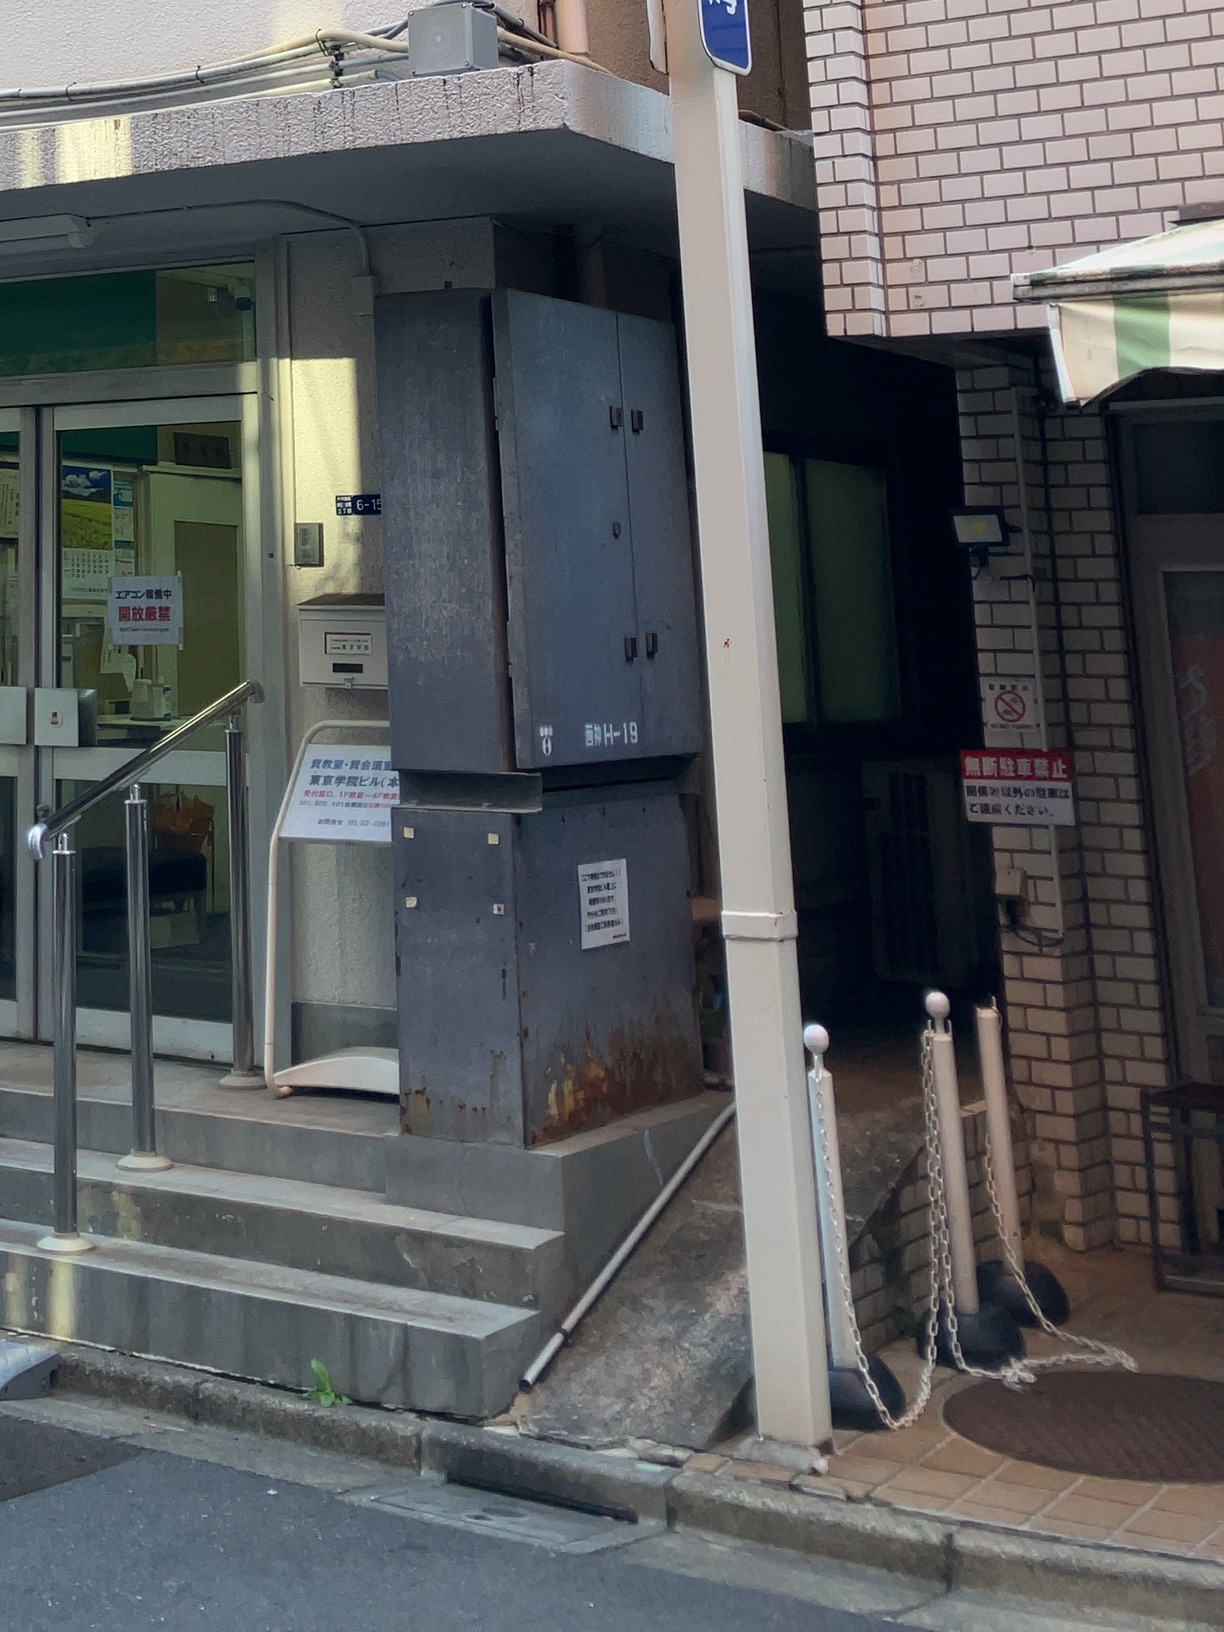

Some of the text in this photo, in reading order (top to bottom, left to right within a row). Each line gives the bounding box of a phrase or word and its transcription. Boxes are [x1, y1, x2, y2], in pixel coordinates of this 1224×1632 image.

[115, 588, 172, 599] エアコン稼働中
[118, 605, 171, 622] 開放厳禁
[965, 756, 1069, 779] 無断駐車禁止
